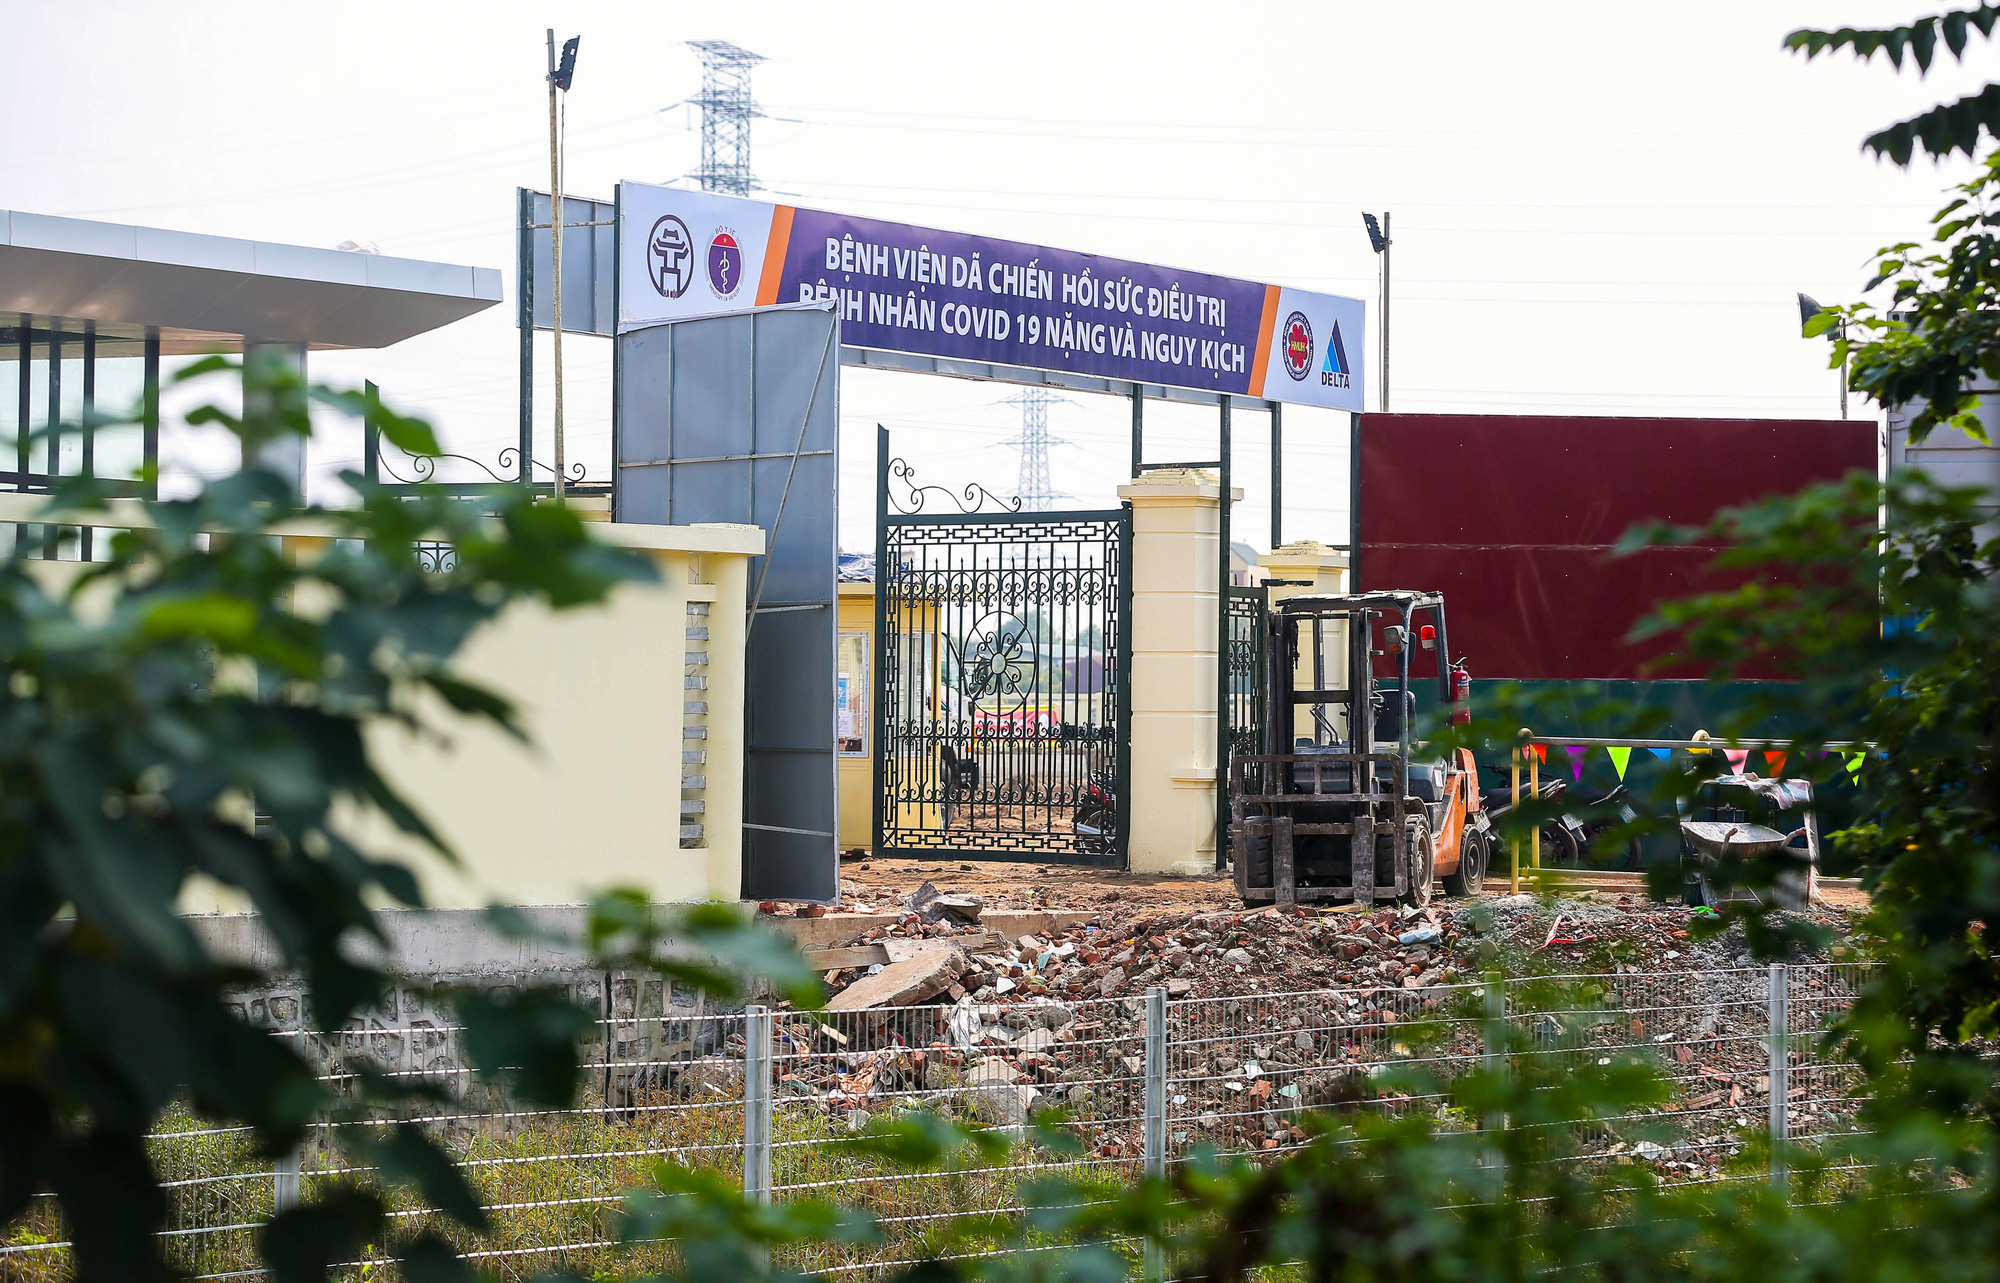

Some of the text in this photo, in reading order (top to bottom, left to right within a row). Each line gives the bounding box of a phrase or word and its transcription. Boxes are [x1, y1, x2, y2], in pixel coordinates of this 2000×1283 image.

[825, 233, 1227, 336] BỆNH VIỆN DÃ CHIẾN HỒI SỨC ĐIỀU TRỊ
[869, 285, 936, 332] NHÂN
[940, 301, 1010, 341] COVID
[1016, 314, 1041, 345] 19
[1045, 311, 1106, 358] NẶNG
[1109, 320, 1137, 360] VÀ
[1140, 332, 1197, 367] NGUY
[1200, 341, 1245, 379] KỊCH
[1321, 371, 1350, 390] DELTA
